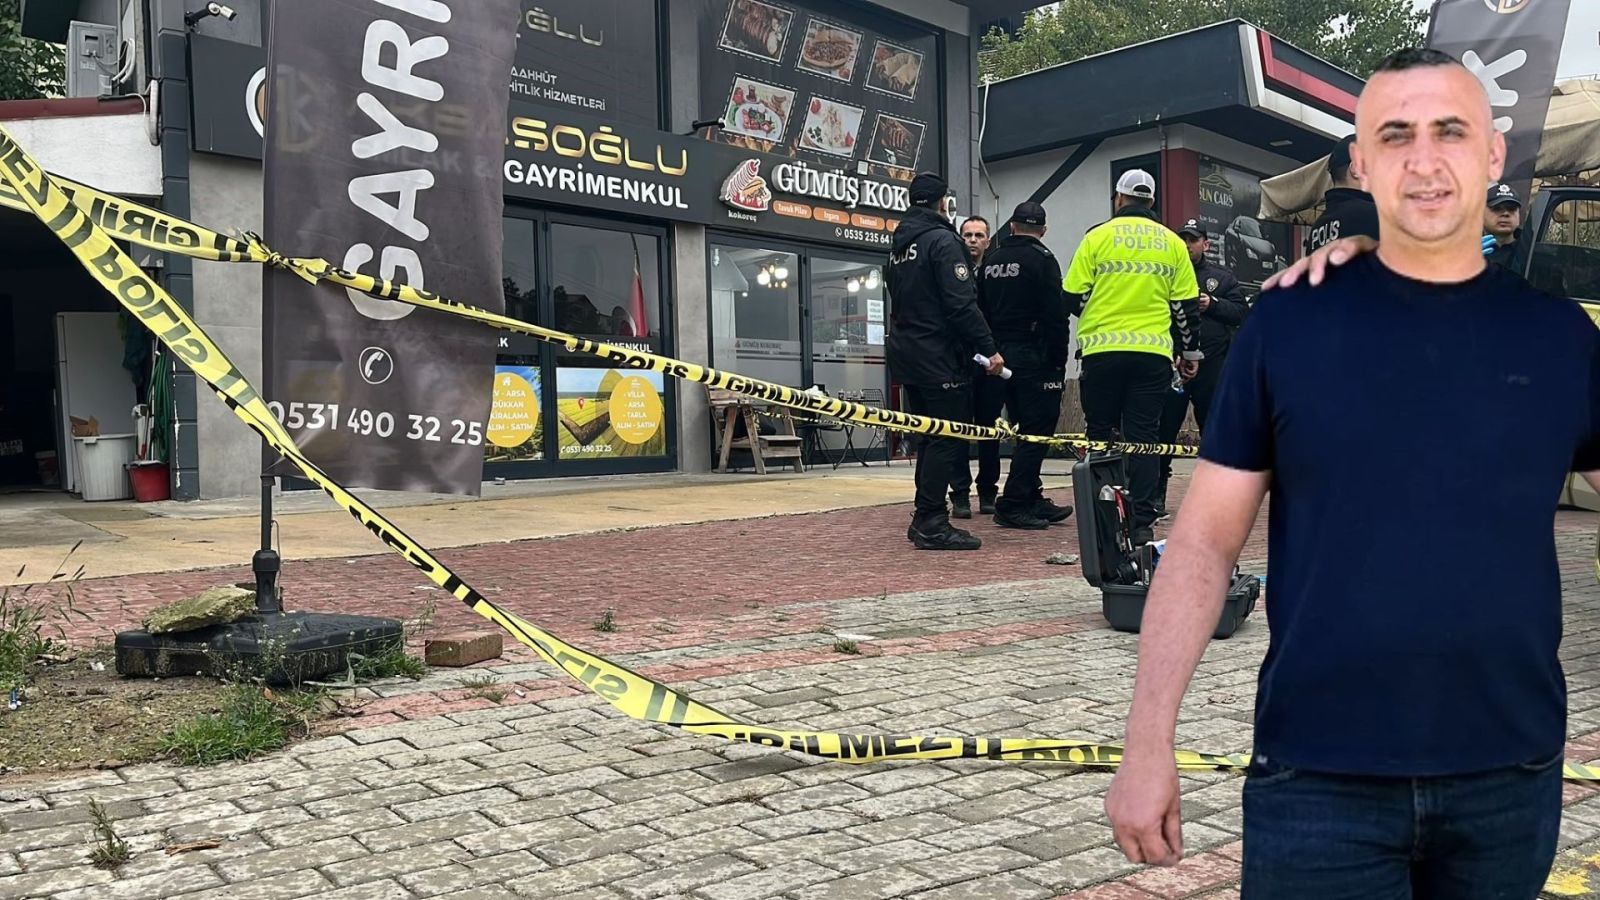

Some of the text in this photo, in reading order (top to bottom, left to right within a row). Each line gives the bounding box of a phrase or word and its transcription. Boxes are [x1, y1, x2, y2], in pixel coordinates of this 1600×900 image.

[520, 7, 604, 46] ĞLU
[510, 65, 558, 85] AAHHÜT
[509, 79, 606, 111] HİTLİK HİZMETLERİ
[506, 117, 688, 176] ŞOĞLU
[503, 160, 689, 209] GAYRİMENKUL
[774, 161, 860, 208] GÜMÜŞ
[1214, 191, 1234, 208] CARS
[728, 210, 757, 222] kokoreç
[844, 228, 864, 240] 0535
[864, 232, 878, 242] 235
[880, 234, 890, 244] 64
[268, 400, 482, 446] 0531 490 32 25
[627, 411, 647, 419] TARLA
